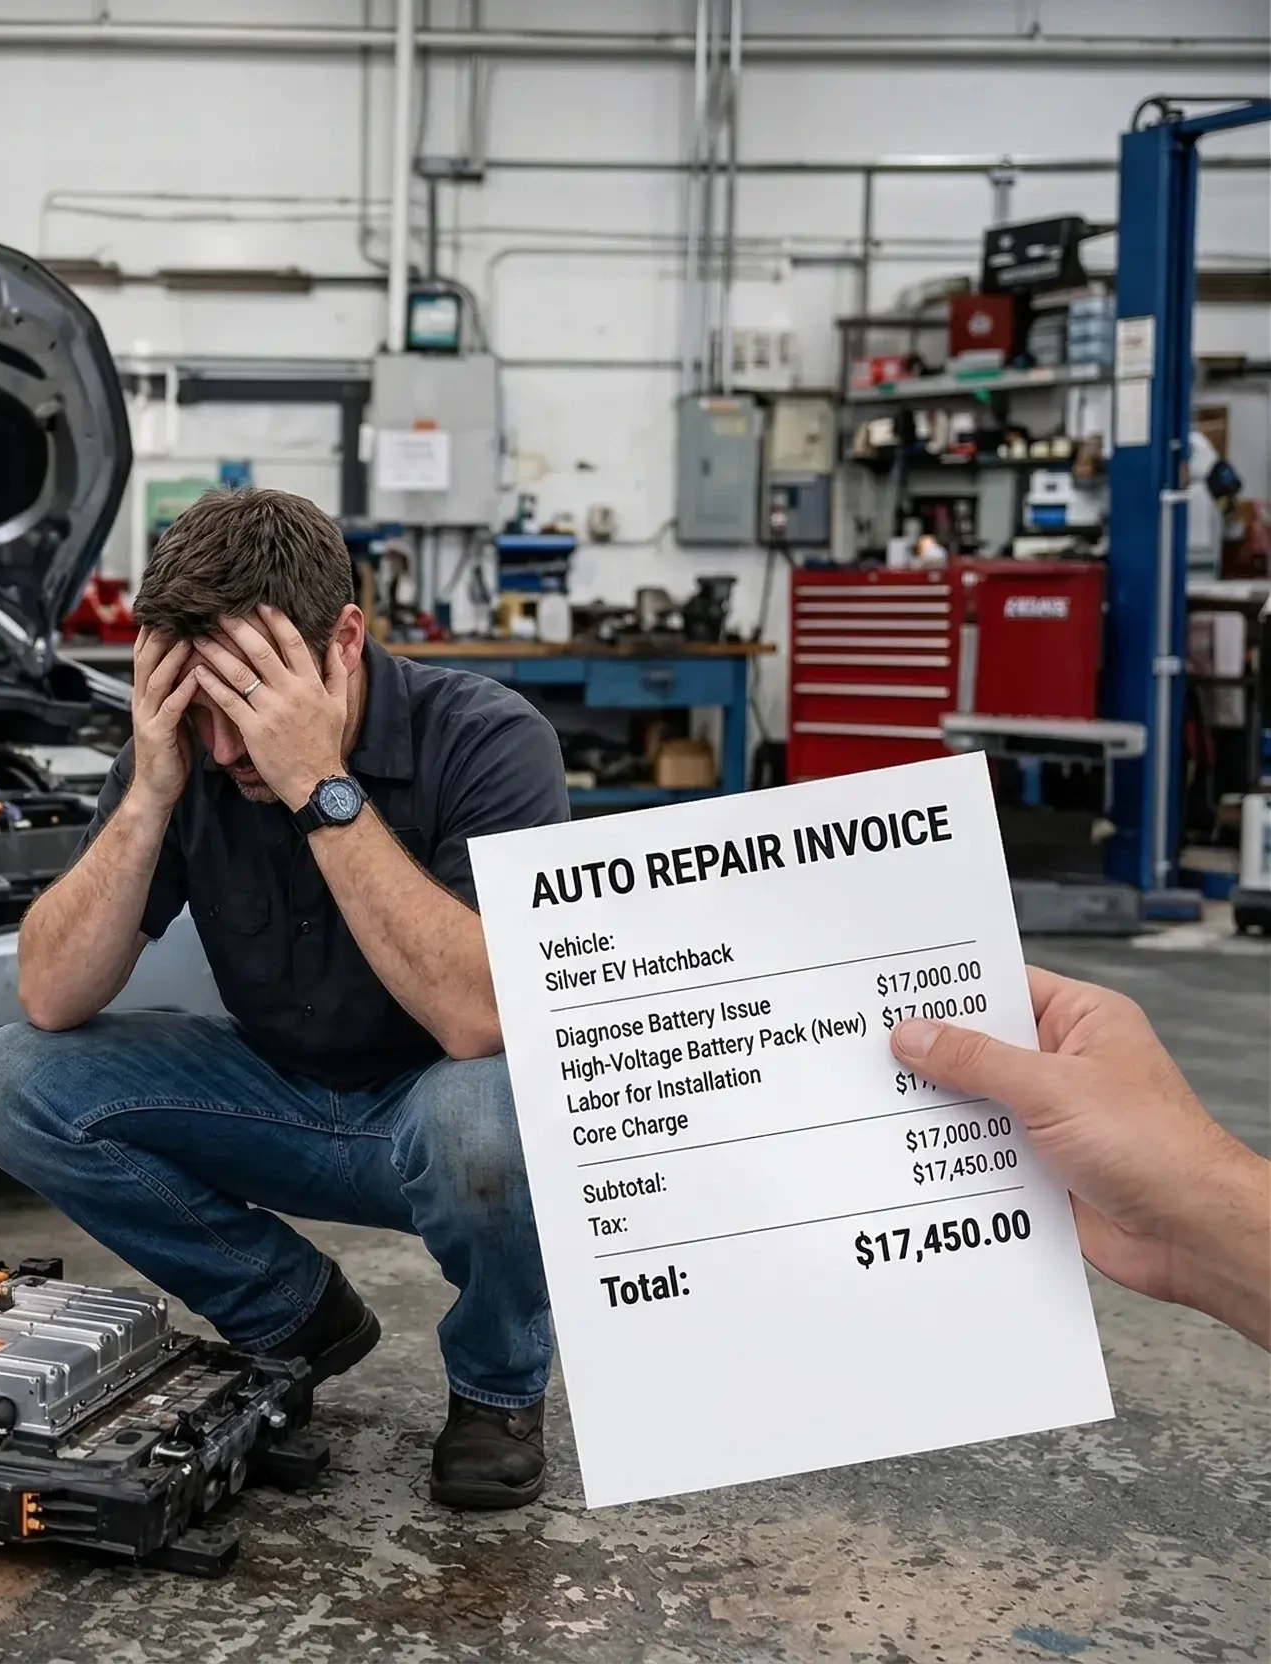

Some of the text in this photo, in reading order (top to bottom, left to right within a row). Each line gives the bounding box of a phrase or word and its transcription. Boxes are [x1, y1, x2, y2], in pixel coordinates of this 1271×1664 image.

[533, 805, 953, 909] AUTO REPAIR INVOICE
[539, 932, 615, 961] Vehicle:
[545, 942, 735, 992] Silver EV Hatchback
[556, 960, 982, 1049] Diagnose Battery Issue $17,000.00
[561, 993, 988, 1083] High-Voltage Battery Pack (New) $17000.00
[567, 1067, 762, 1114] Labor for Installation
[573, 1111, 689, 1146] Core Charge
[583, 1116, 1012, 1205] Subtotal: $17,000.00
[588, 1148, 1018, 1237] Tax: $17,450.00
[600, 1209, 1031, 1308] Total: $17,450.00
